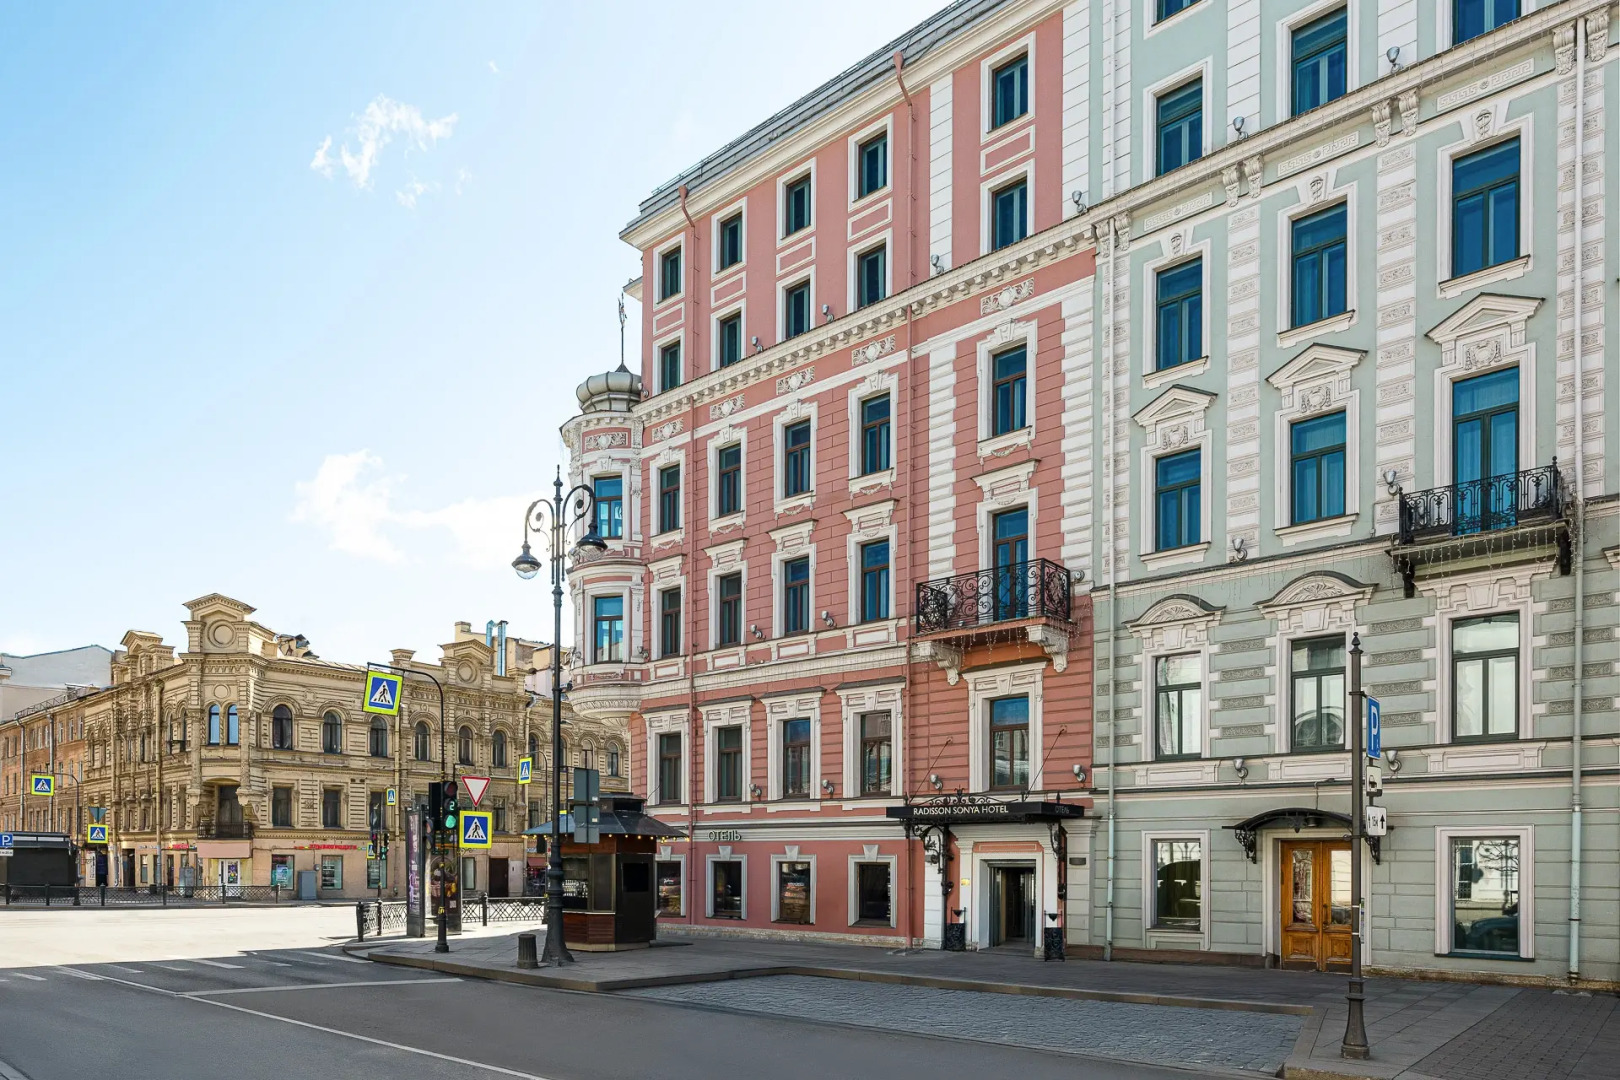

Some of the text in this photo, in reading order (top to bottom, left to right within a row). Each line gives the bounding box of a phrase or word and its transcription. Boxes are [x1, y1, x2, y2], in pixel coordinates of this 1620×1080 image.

[913, 805, 1008, 815] RADISSON SONYA HOTEL
[708, 830, 742, 841] ОТЕЛЬ
